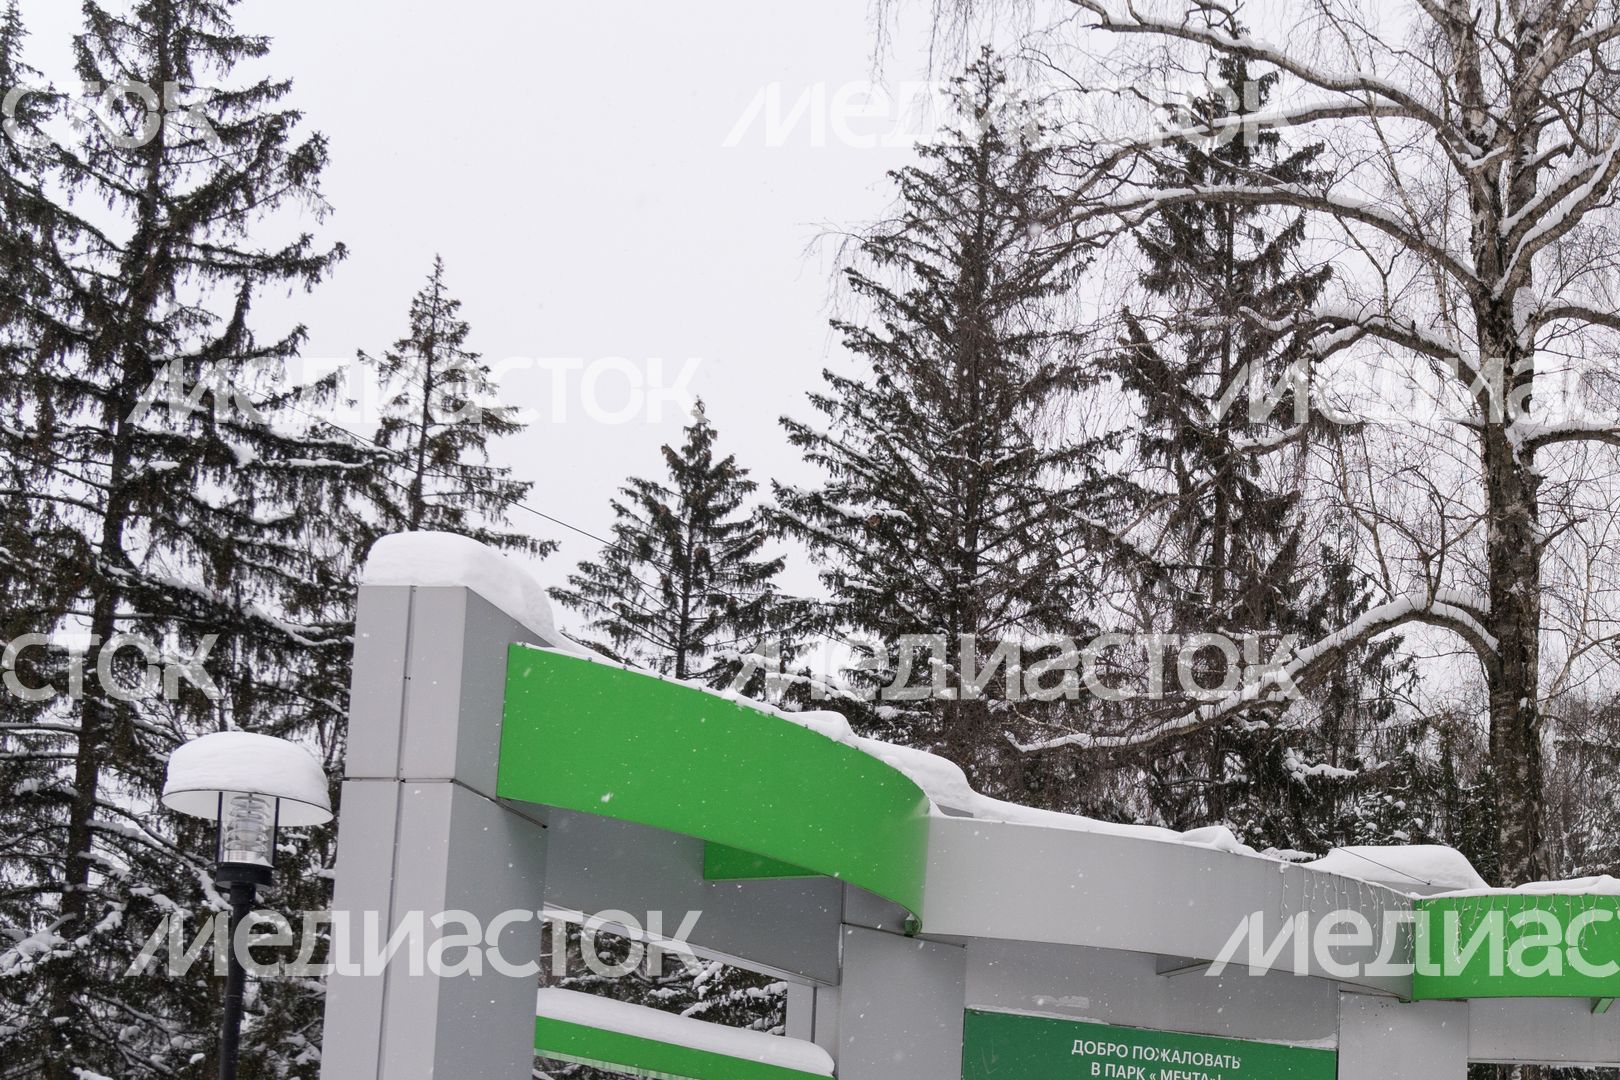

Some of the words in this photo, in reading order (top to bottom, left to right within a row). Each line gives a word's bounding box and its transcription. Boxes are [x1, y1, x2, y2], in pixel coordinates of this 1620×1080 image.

[1071, 1040, 1129, 1058] ДОБРО
[1132, 1045, 1241, 1069] ПОЖАЛОВАТЬ
[1091, 1062, 1100, 1076] В
[1105, 1064, 1145, 1080] ПАРК
